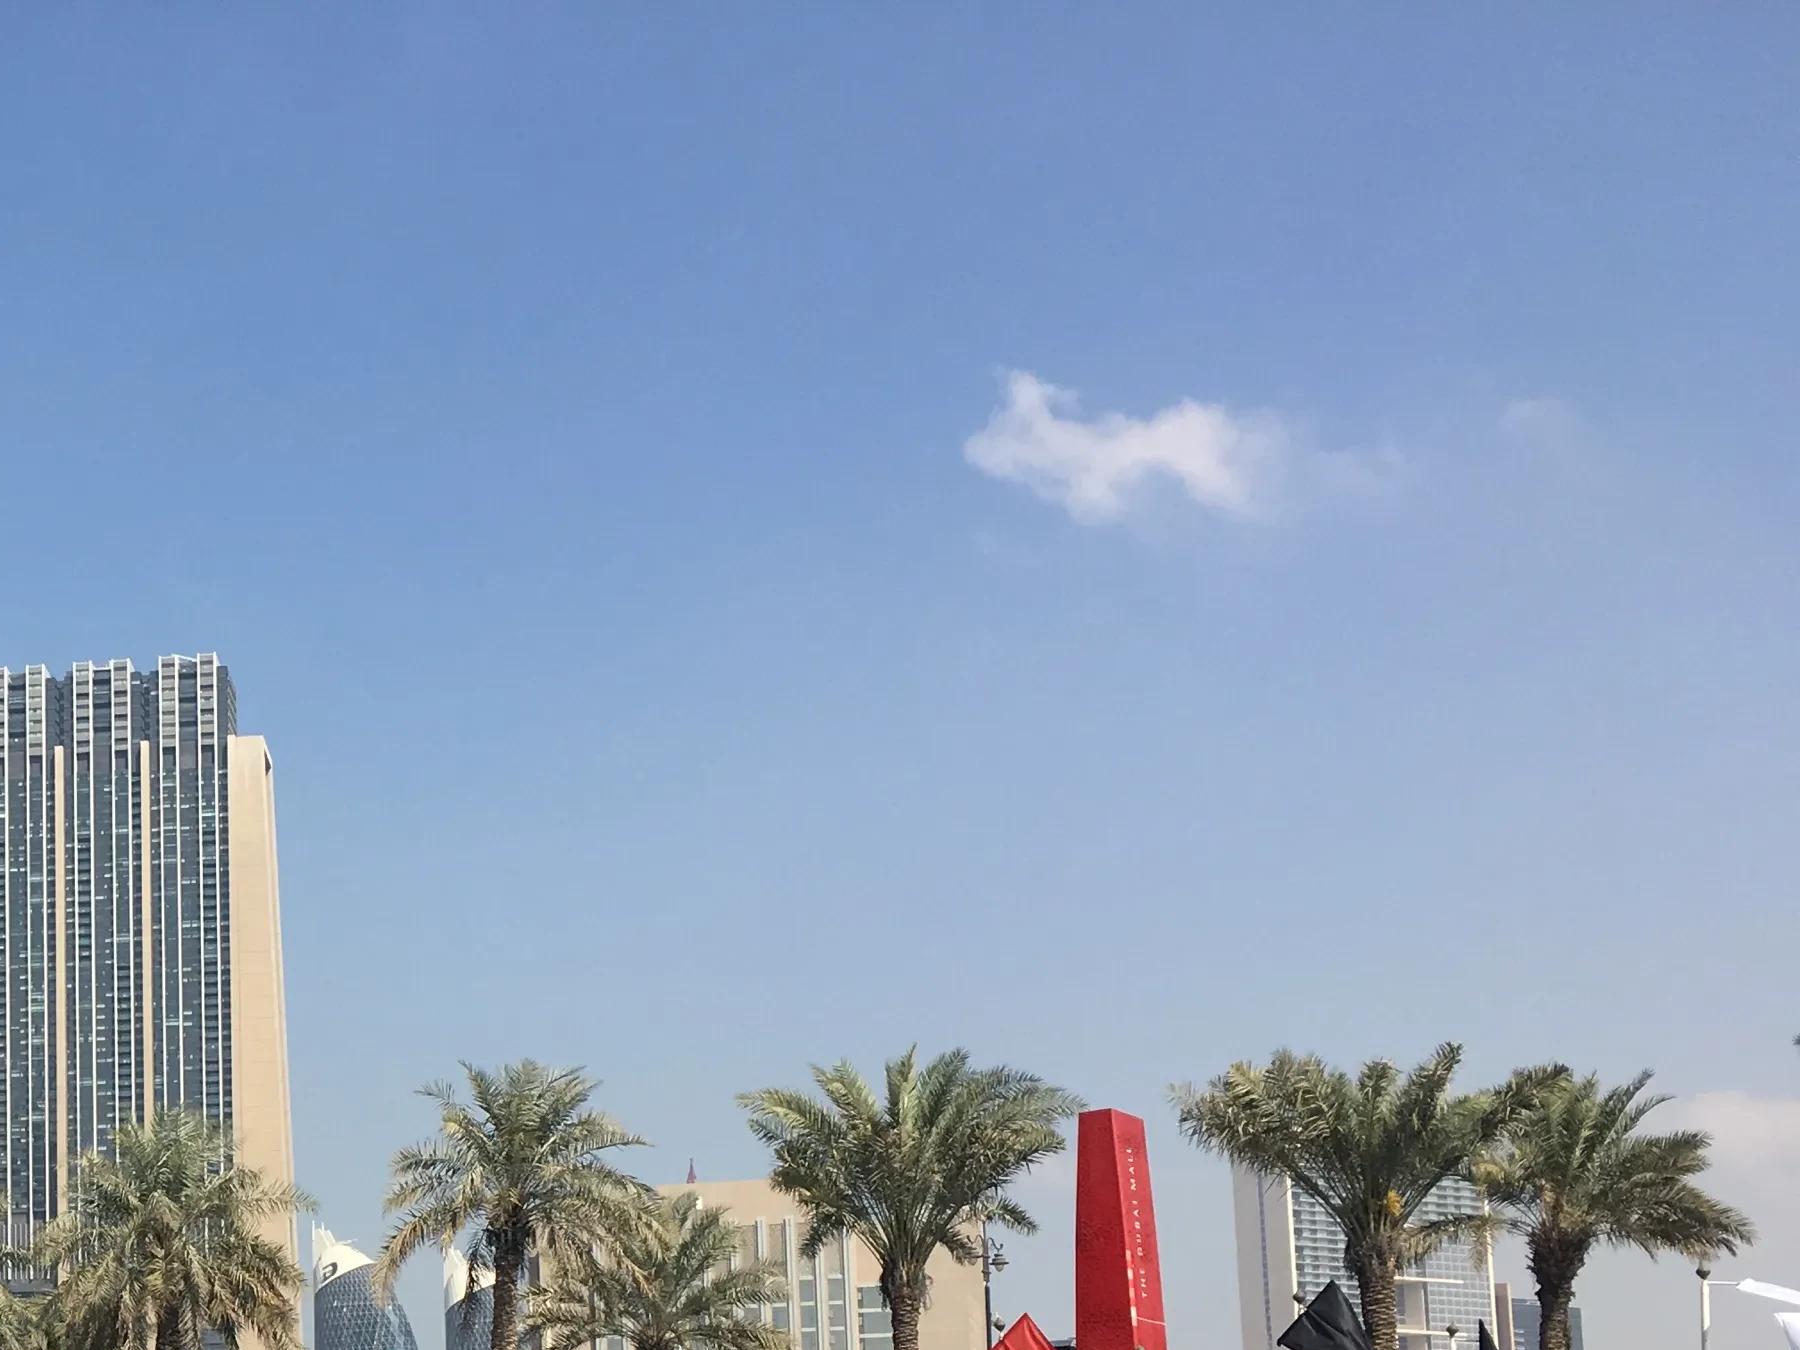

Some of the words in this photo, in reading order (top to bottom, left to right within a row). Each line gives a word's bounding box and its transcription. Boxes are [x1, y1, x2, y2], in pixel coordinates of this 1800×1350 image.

[1125, 1145, 1137, 1192] MALL
[1131, 1200, 1144, 1257] DUBAI
[1139, 1267, 1148, 1299] THE
